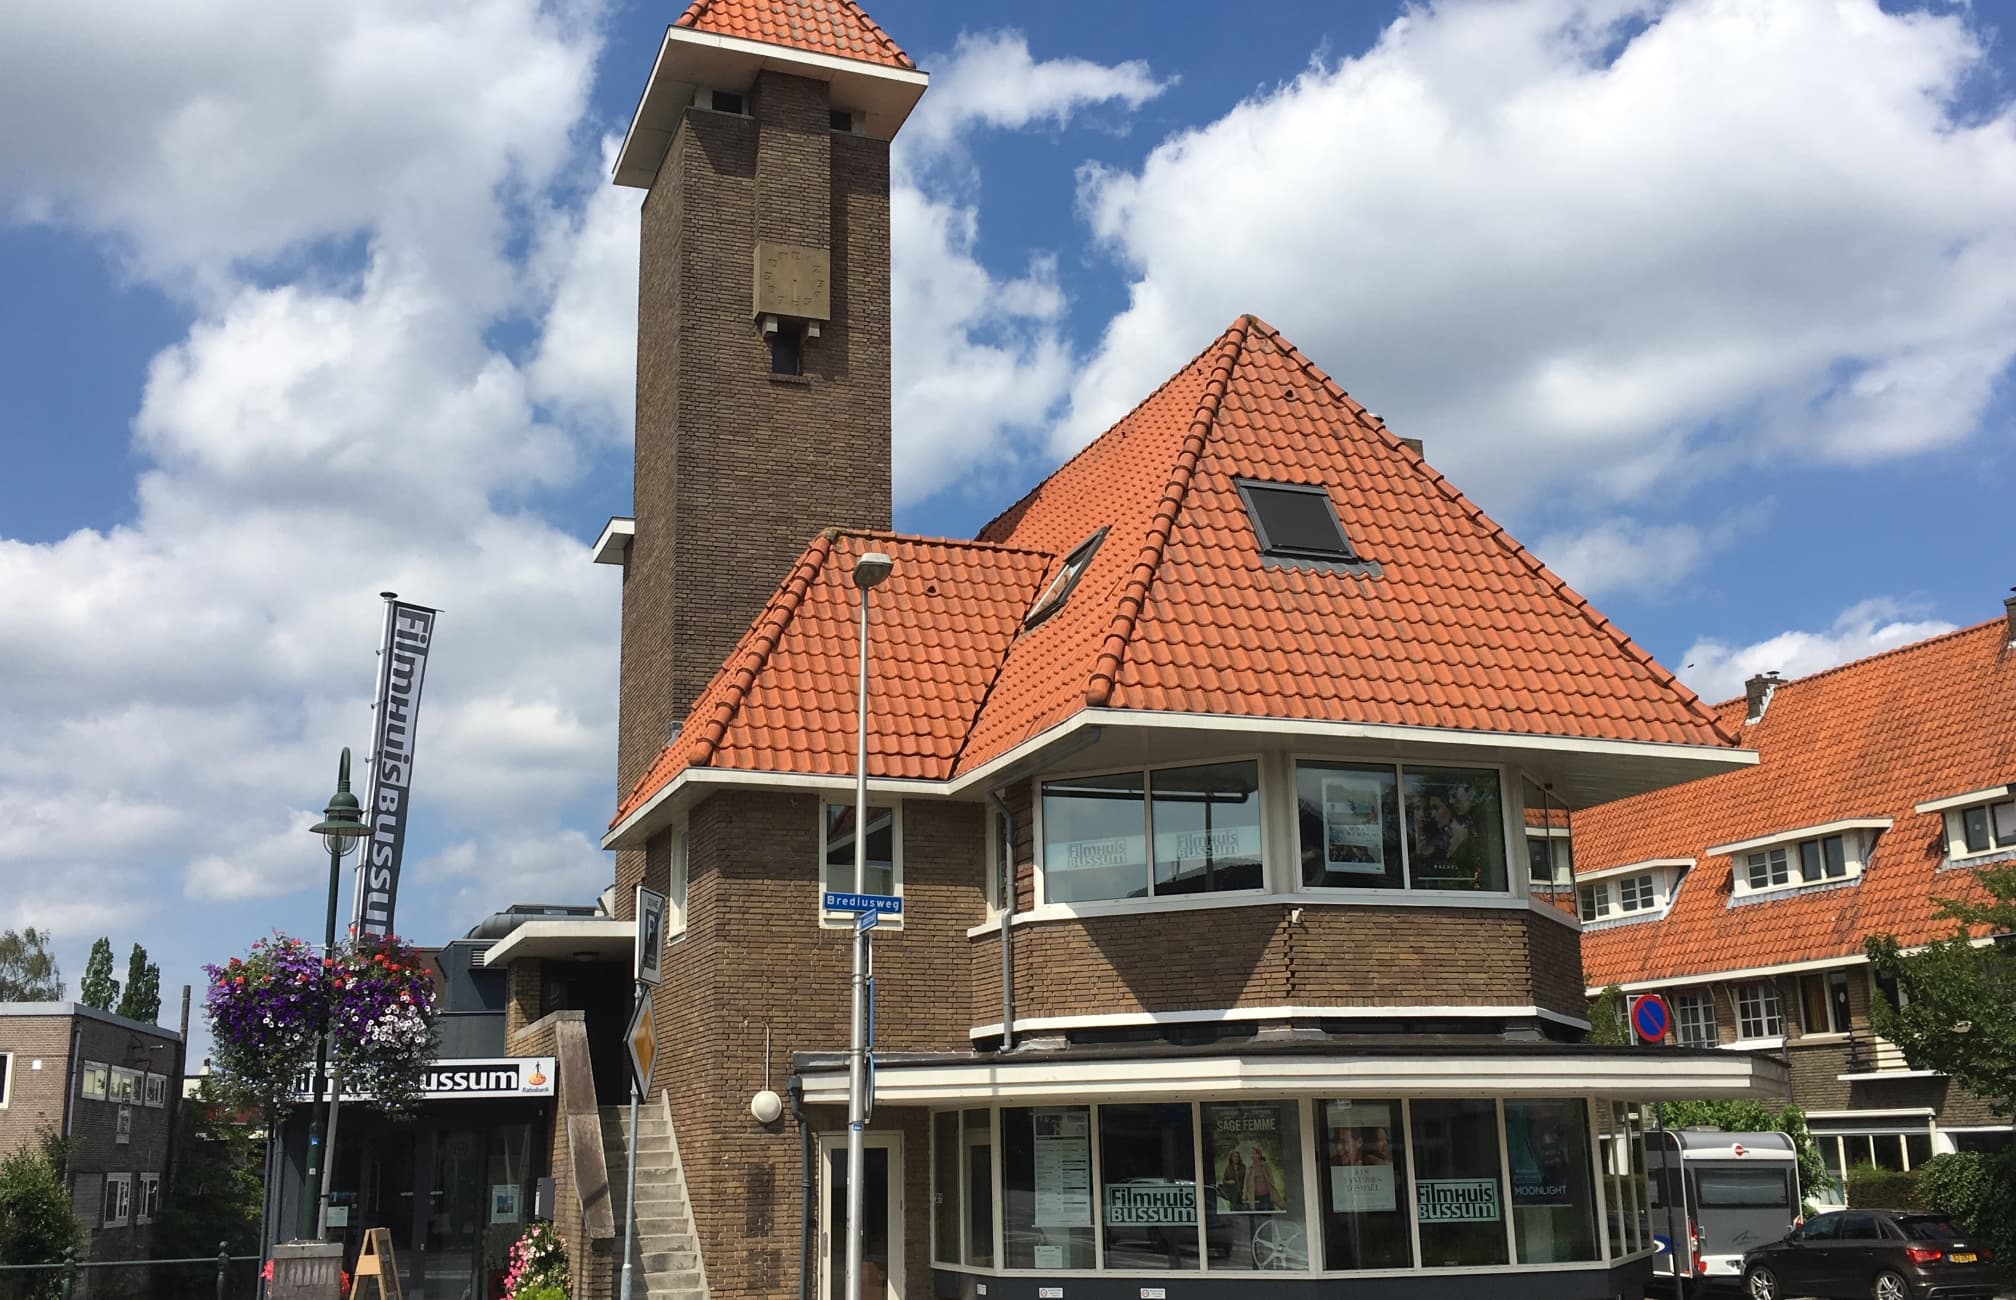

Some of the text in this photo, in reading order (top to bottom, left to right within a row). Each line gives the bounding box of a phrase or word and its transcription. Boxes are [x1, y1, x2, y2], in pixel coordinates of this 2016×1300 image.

[420, 1071, 518, 1091] ussum
[1217, 1118, 1276, 1132] SAGE FEMME
[1514, 1184, 1567, 1196] MOONLIGHT
